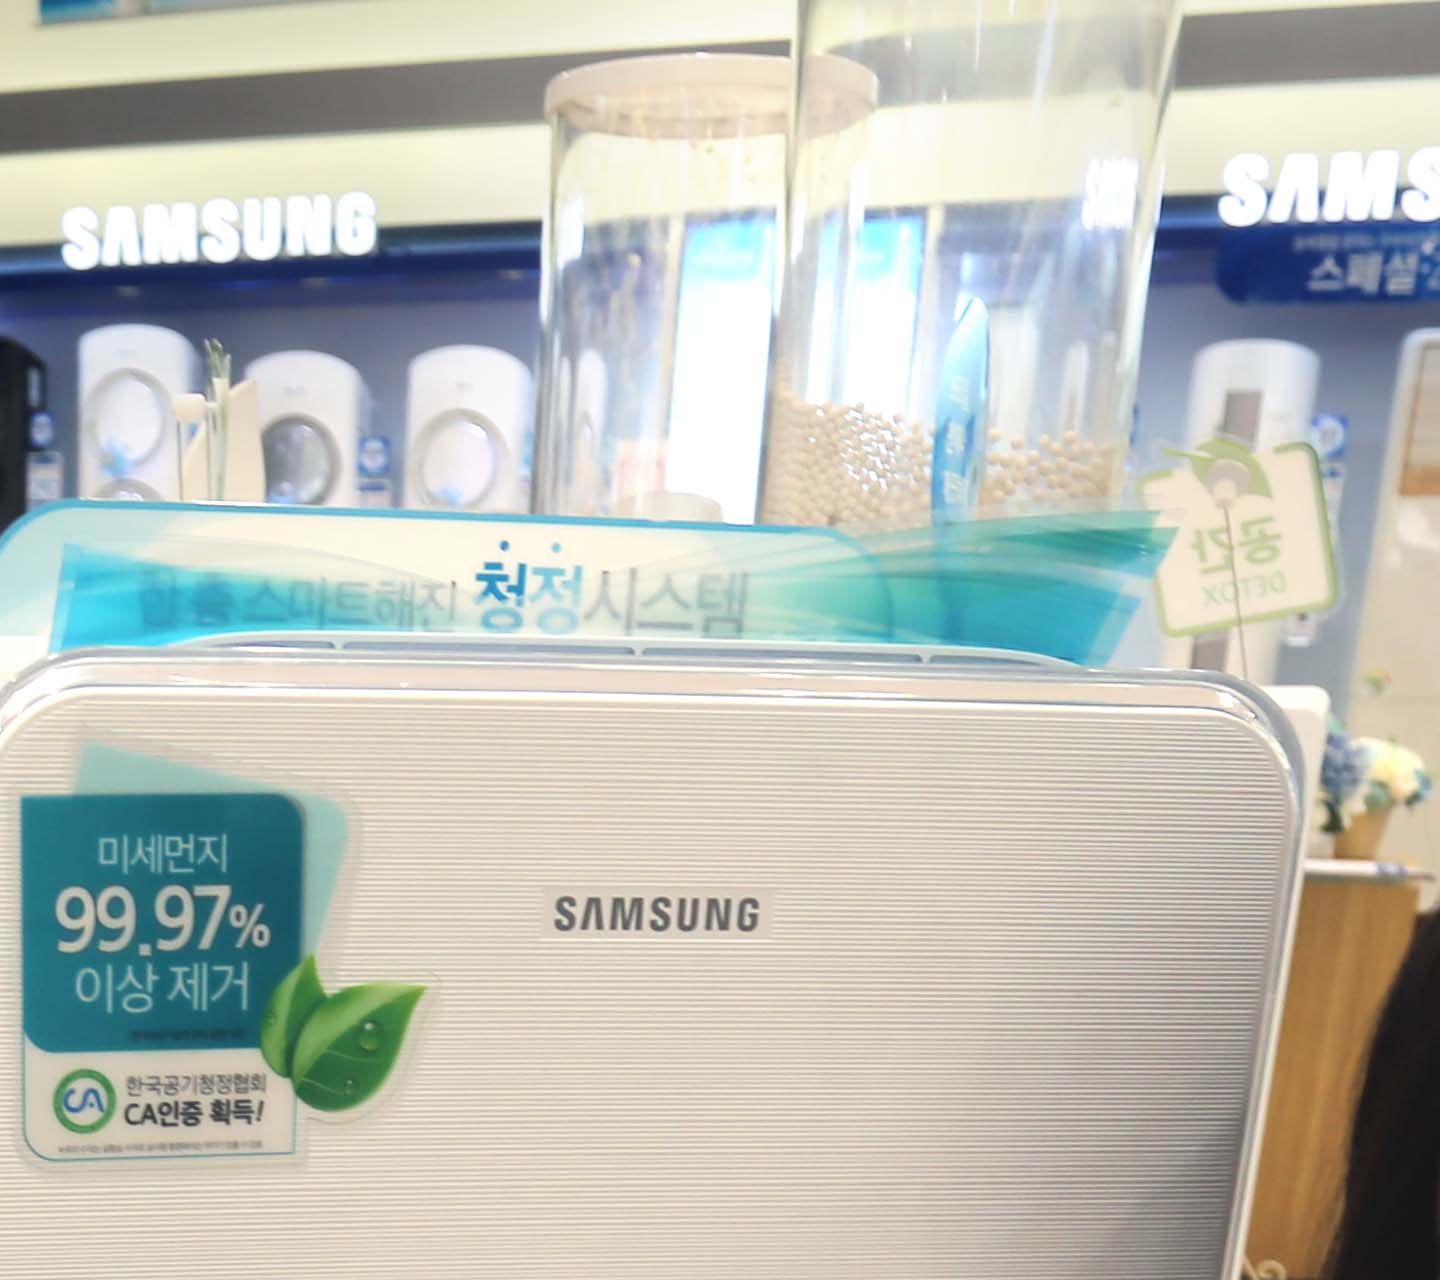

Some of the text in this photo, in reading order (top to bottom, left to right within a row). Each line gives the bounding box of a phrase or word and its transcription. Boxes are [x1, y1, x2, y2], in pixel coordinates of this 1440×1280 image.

[61, 192, 377, 270] SAMSUNG
[246, 541, 750, 637] 스마트해진 청정시스템
[97, 834, 228, 875] 미세먼지
[55, 885, 271, 956] 99.97%
[554, 896, 760, 932] SAMSUNG
[75, 960, 250, 1015] 이상 제거
[124, 1098, 265, 1127] CA인증 획득!
